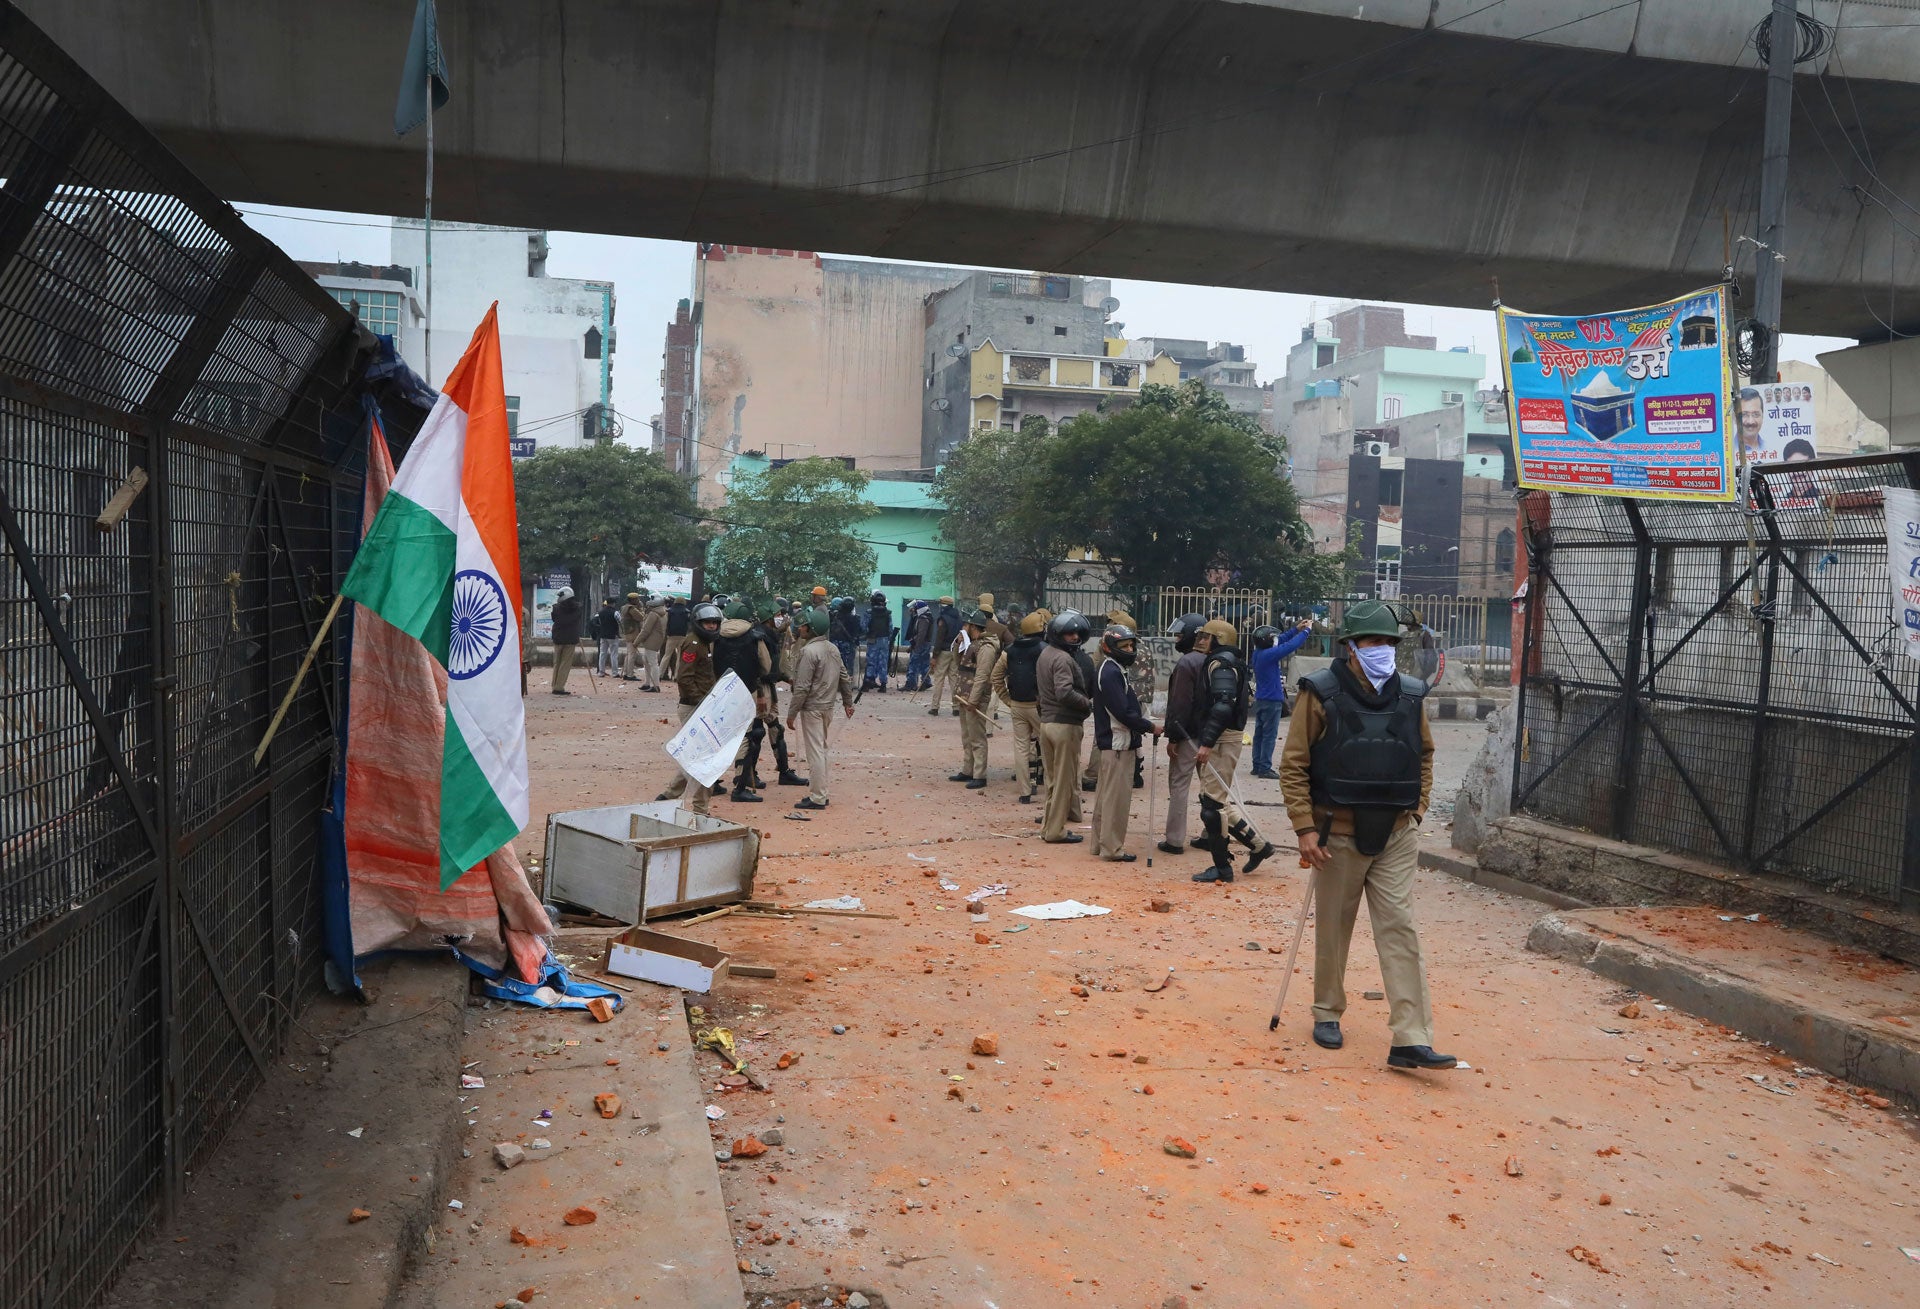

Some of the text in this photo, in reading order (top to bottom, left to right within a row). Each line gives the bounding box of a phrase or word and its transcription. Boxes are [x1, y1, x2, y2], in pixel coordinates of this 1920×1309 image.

[1550, 330, 1577, 340] मदार
[1576, 318, 1615, 343] 603
[1589, 347, 1625, 367] मदार
[1626, 332, 1673, 380] उर्स
[1768, 406, 1800, 419] जो कहा
[1778, 422, 1811, 436] सो किया
[1769, 450, 1777, 460] तो
